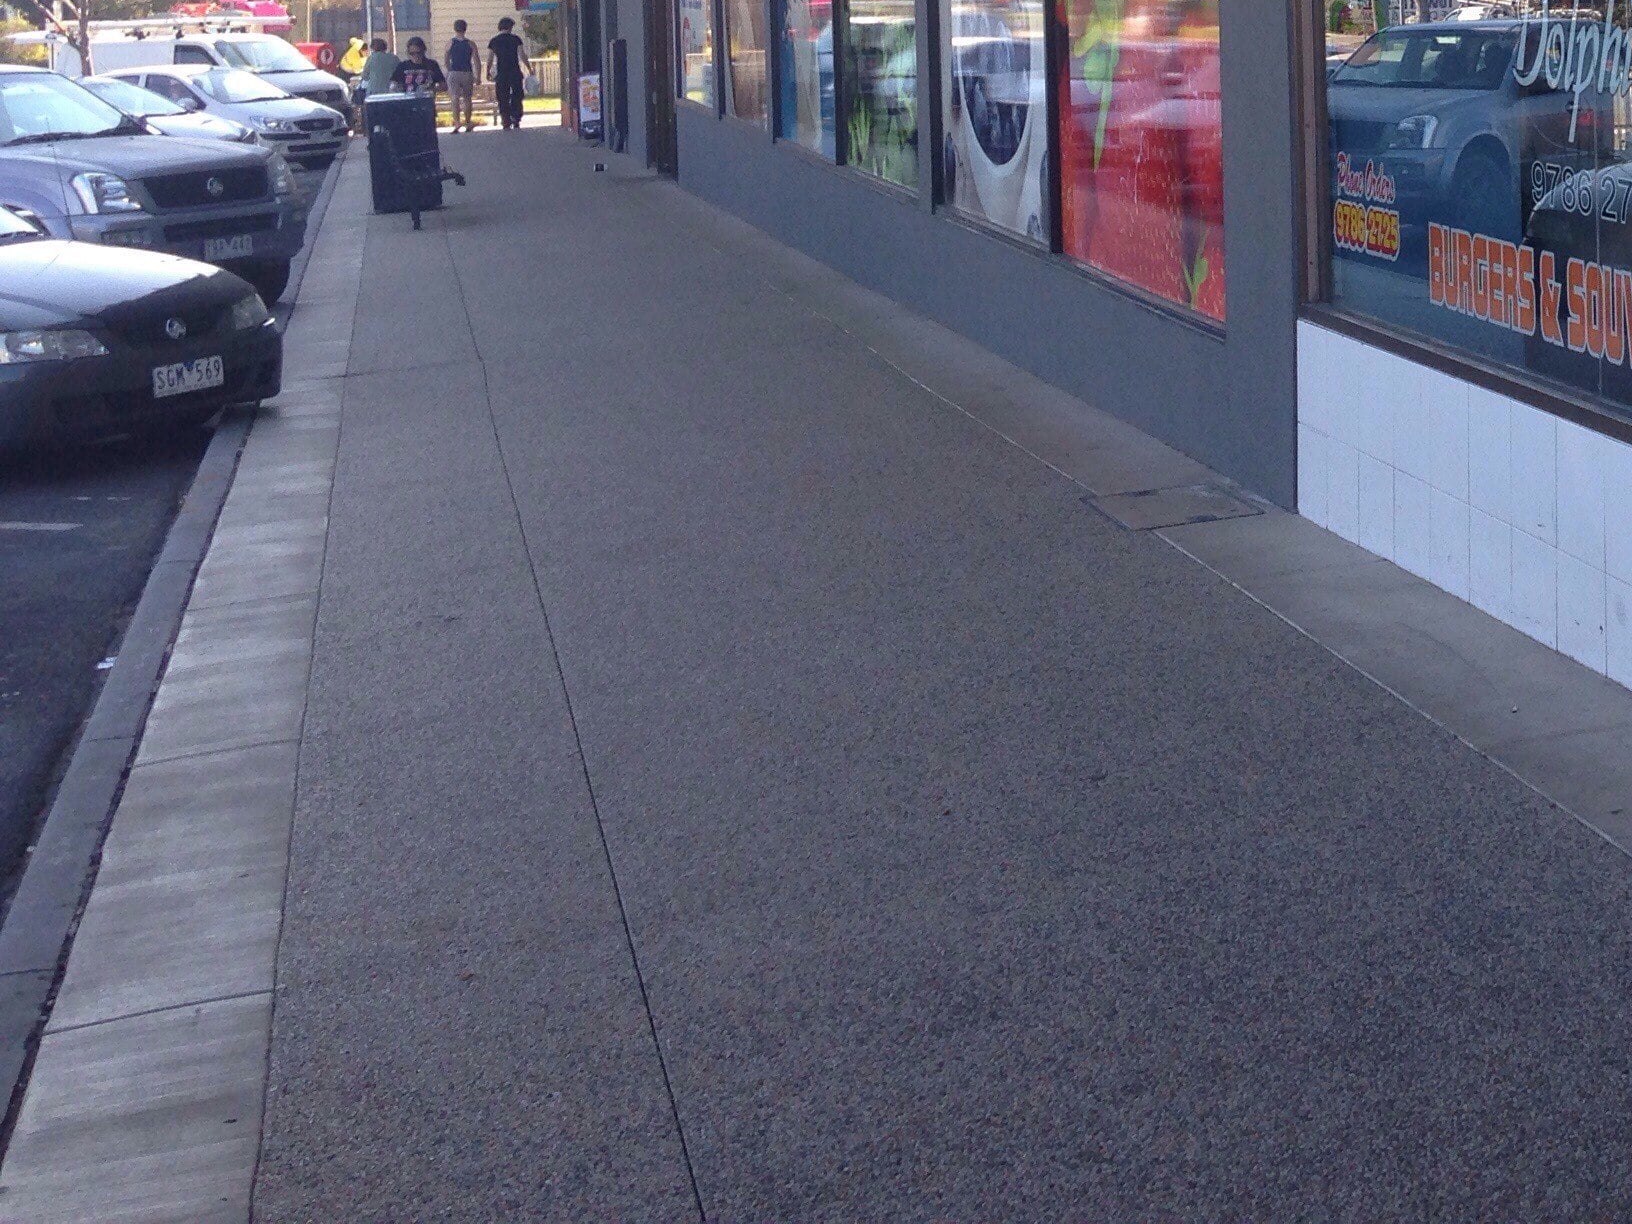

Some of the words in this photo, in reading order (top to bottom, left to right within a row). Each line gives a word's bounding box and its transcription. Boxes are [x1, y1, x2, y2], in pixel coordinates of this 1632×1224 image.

[1531, 160, 1593, 216] 9786
[1334, 199, 1366, 254] 9786
[1365, 205, 1400, 262] 2725
[1429, 222, 1535, 336] BURGERS
[1540, 250, 1565, 347] &
